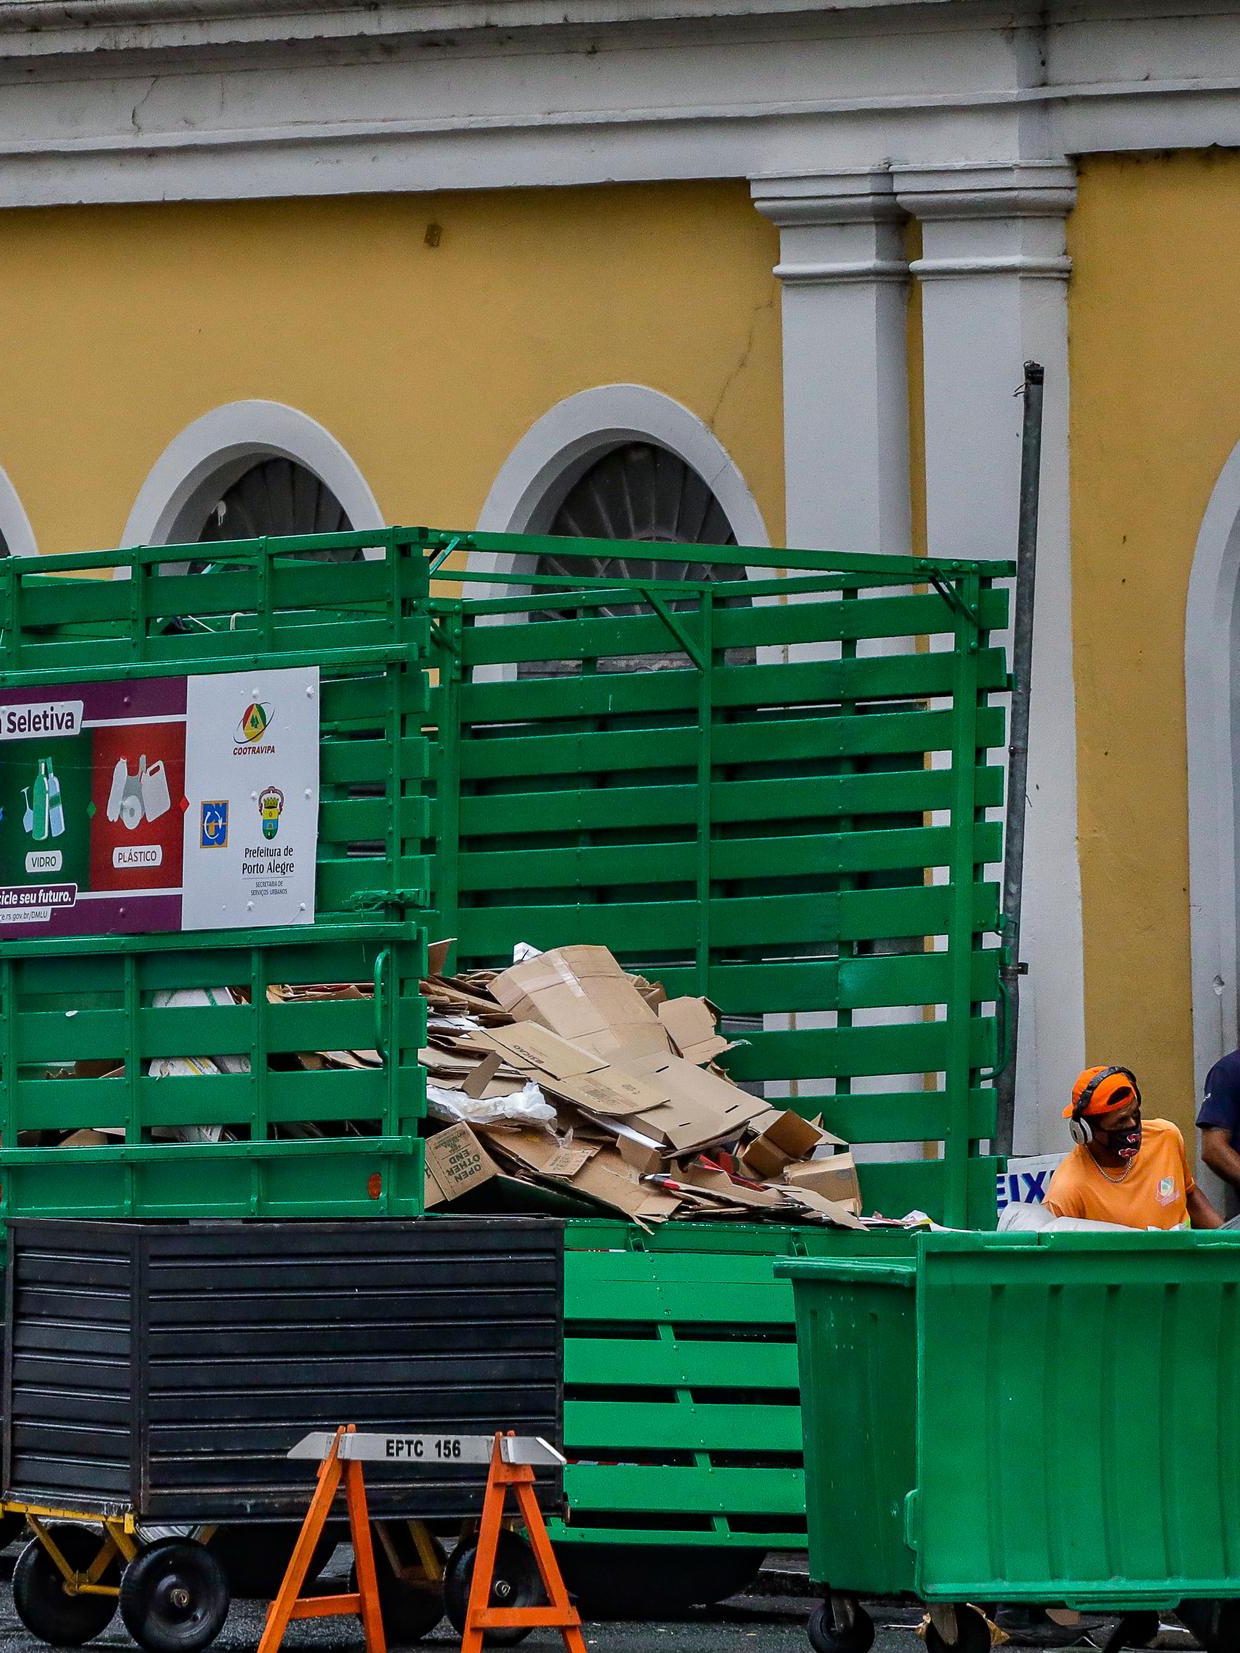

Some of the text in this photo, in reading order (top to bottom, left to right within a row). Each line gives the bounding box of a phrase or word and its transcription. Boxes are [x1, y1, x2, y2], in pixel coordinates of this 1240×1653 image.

[6, 705, 75, 734] Seletiva
[233, 745, 276, 756] COOTRAVIPA
[117, 848, 157, 863] PLÁSTICO
[244, 845, 294, 859] Prefeitura de
[31, 855, 57, 868] VIDRO
[241, 859, 295, 876] Porto Alegre
[19, 893, 37, 905] seu
[37, 888, 72, 904] futuro.
[446, 1153, 481, 1176] OTHER
[449, 1149, 470, 1165] END
[454, 1164, 482, 1182] OPEN
[996, 1169, 1056, 1209] EIX
[385, 1439, 461, 1458] EPTC 156
